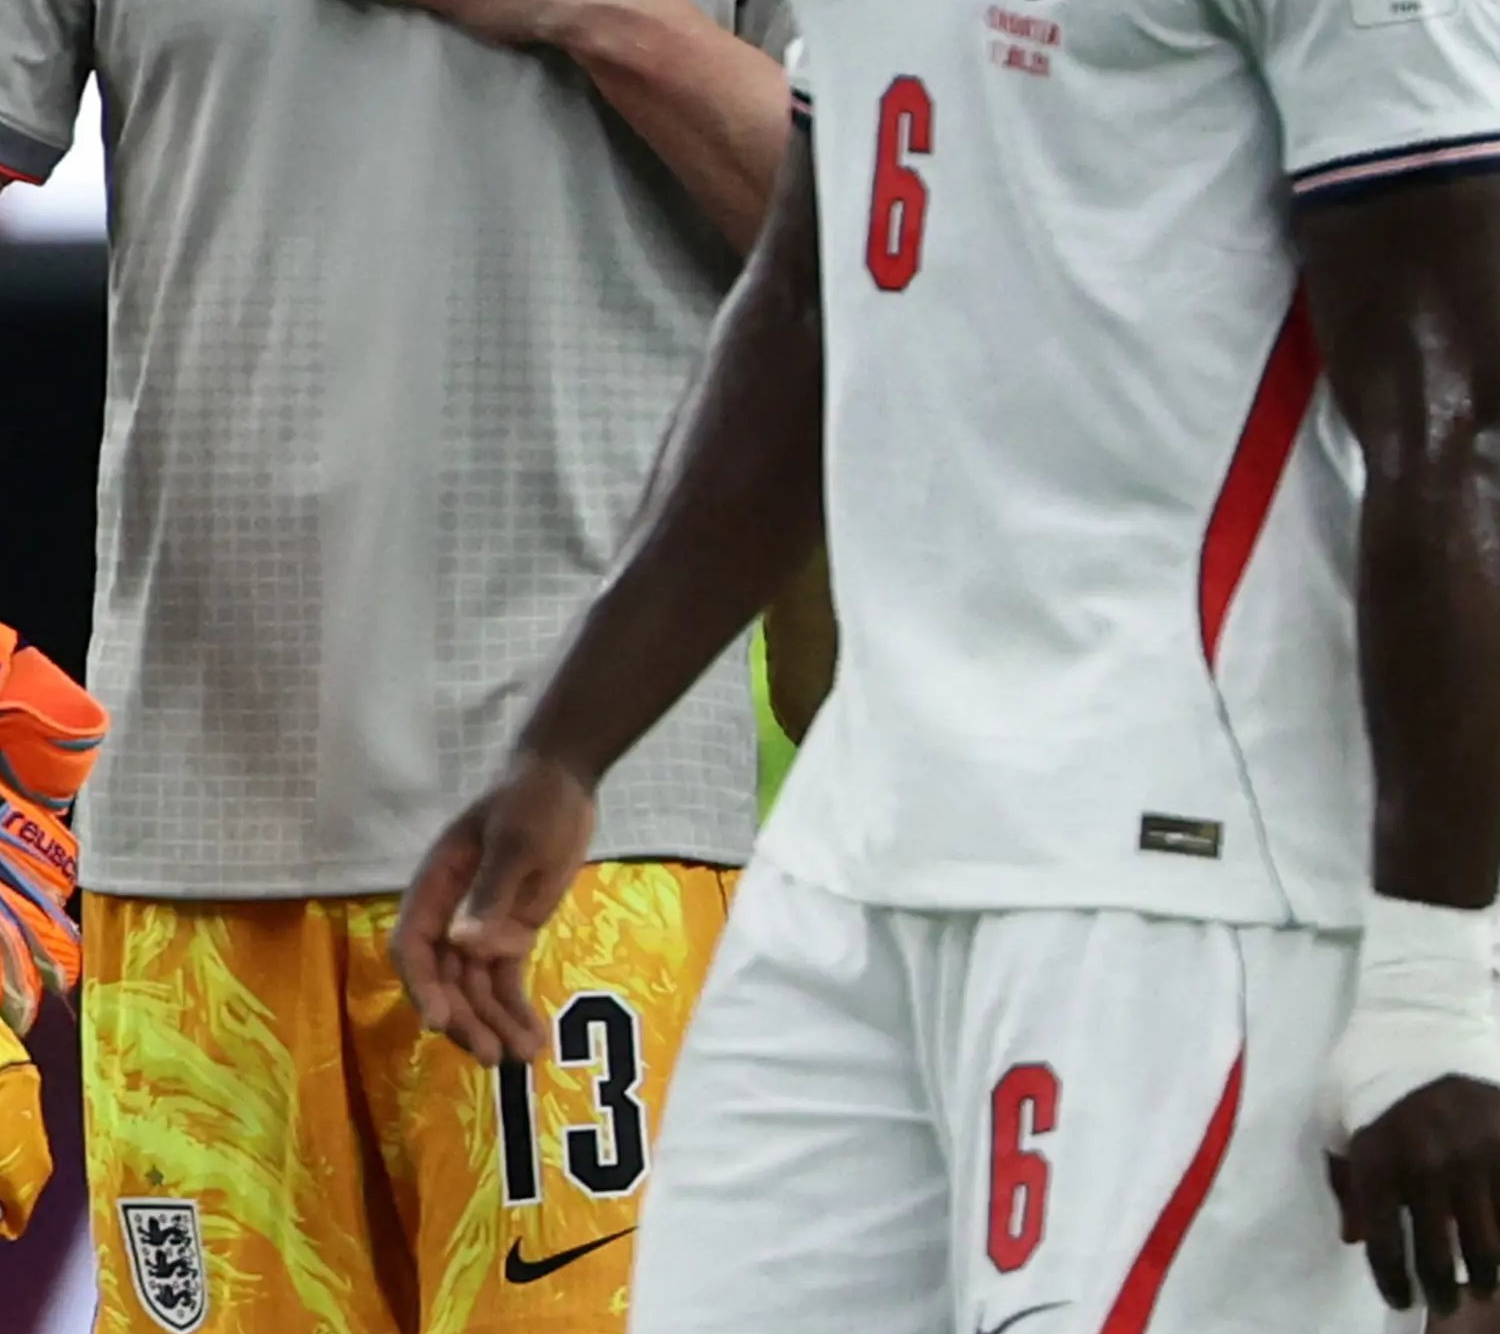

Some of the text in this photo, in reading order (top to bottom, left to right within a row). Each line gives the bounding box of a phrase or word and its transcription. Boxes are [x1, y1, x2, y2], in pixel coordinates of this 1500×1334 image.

[864, 74, 934, 292] 6
[2, 811, 77, 885] reusc
[493, 991, 652, 1209] 13
[985, 1061, 1063, 1274] 6
